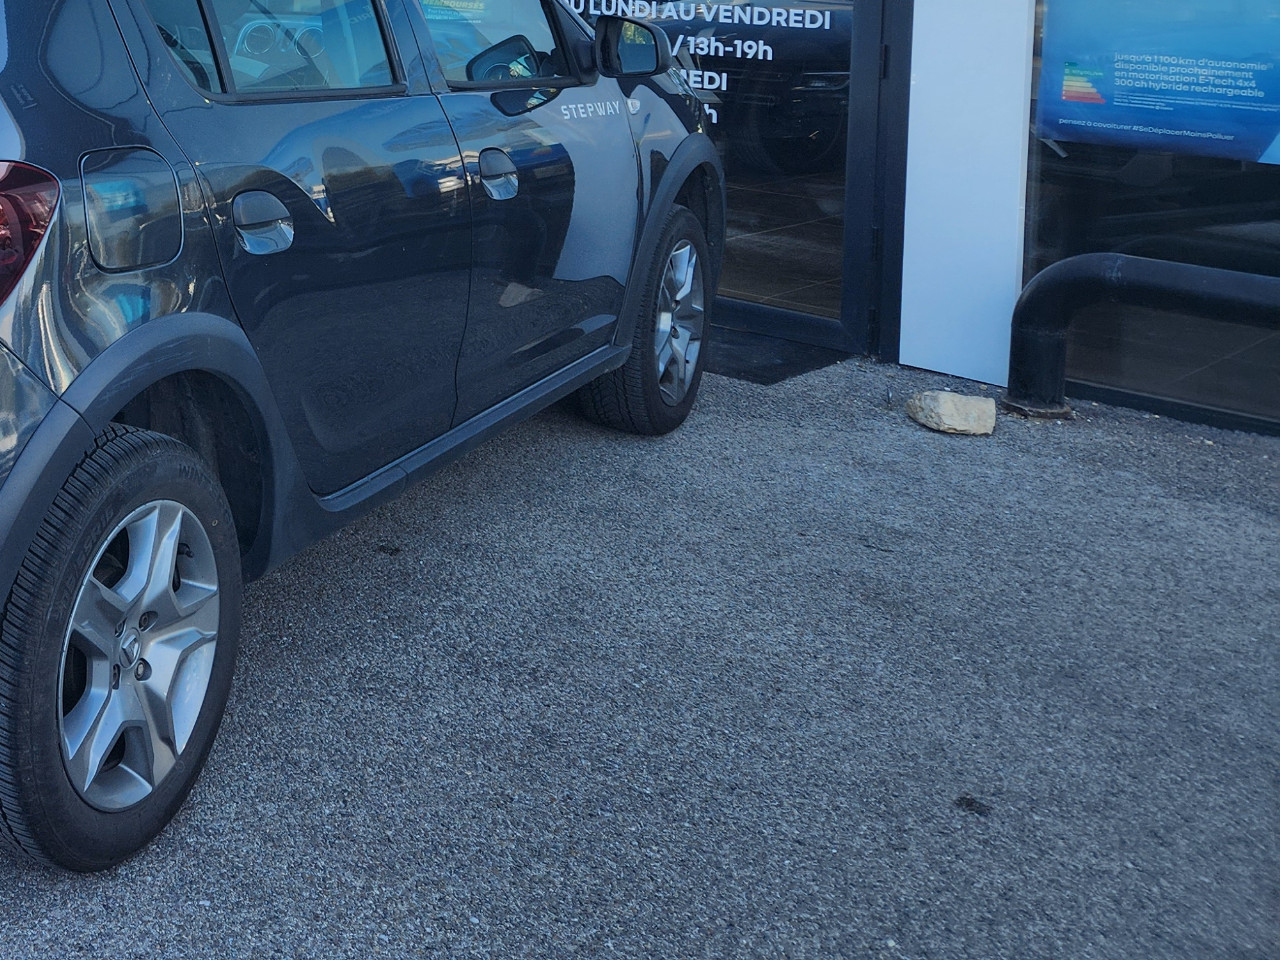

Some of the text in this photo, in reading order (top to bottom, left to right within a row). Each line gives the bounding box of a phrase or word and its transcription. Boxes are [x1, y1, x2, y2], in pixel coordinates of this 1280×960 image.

[661, 1, 696, 21] AU
[700, 3, 831, 30] VENDREDI
[687, 36, 773, 61] 13h-19h
[1114, 52, 1151, 64] jusqu'à
[1178, 56, 1196, 66] km
[1114, 61, 1168, 74] disponible
[1169, 65, 1254, 79] prochainement
[1133, 71, 1197, 84] motorisation
[1198, 75, 1236, 87] E-Tech
[1236, 79, 1257, 88] 4x4
[1114, 78, 1266, 99] 300 ch hybride rechargeable
[560, 100, 621, 120] STEPWAY
[1058, 117, 1086, 126] pensez
[1092, 121, 1131, 131] covoiturer
